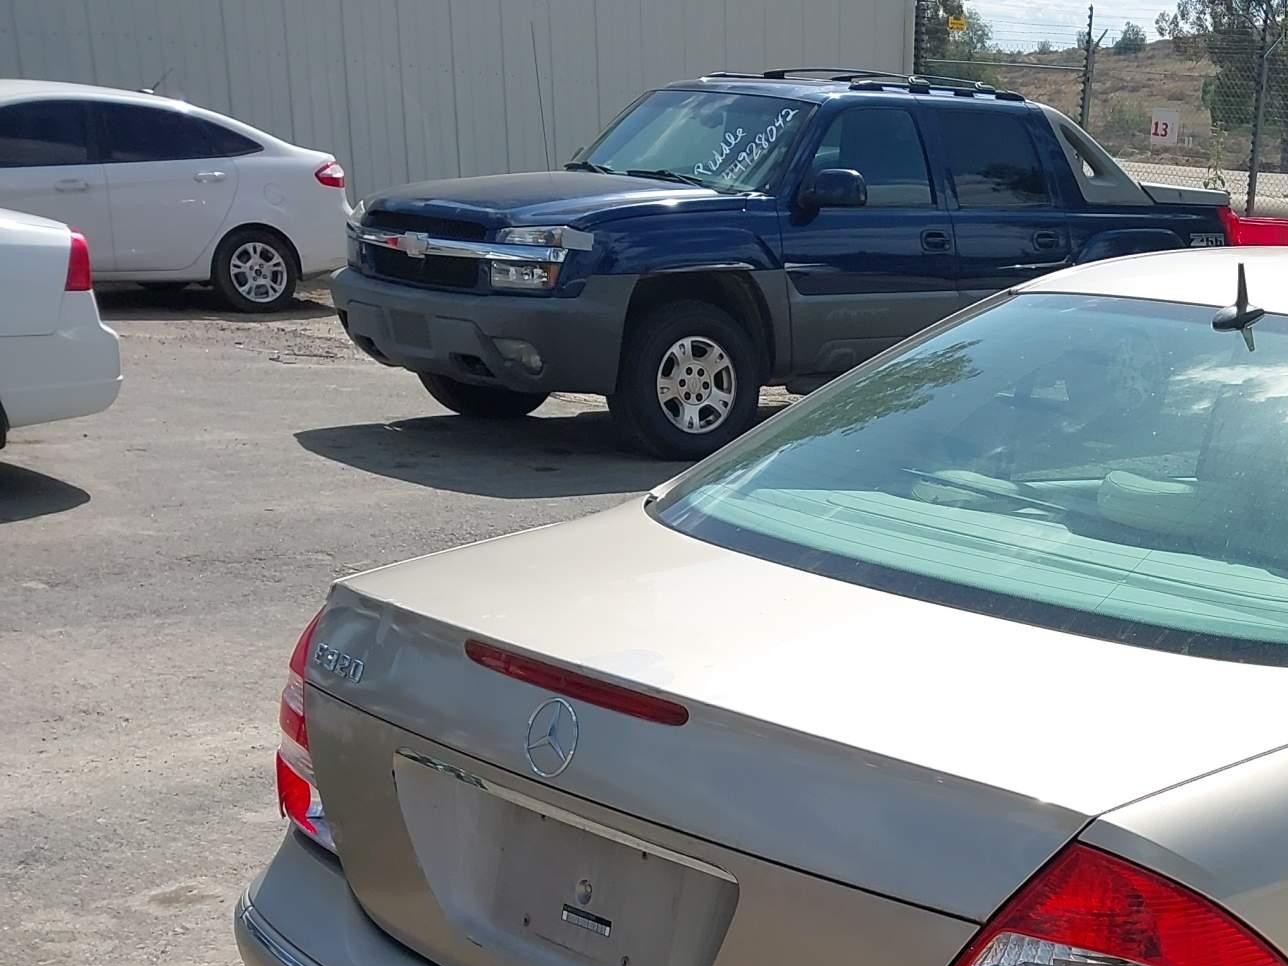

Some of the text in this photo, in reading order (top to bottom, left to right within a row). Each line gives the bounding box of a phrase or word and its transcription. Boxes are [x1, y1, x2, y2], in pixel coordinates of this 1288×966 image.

[721, 108, 799, 180] 44928042
[1152, 120, 1169, 138] 13
[314, 642, 364, 684] E320
